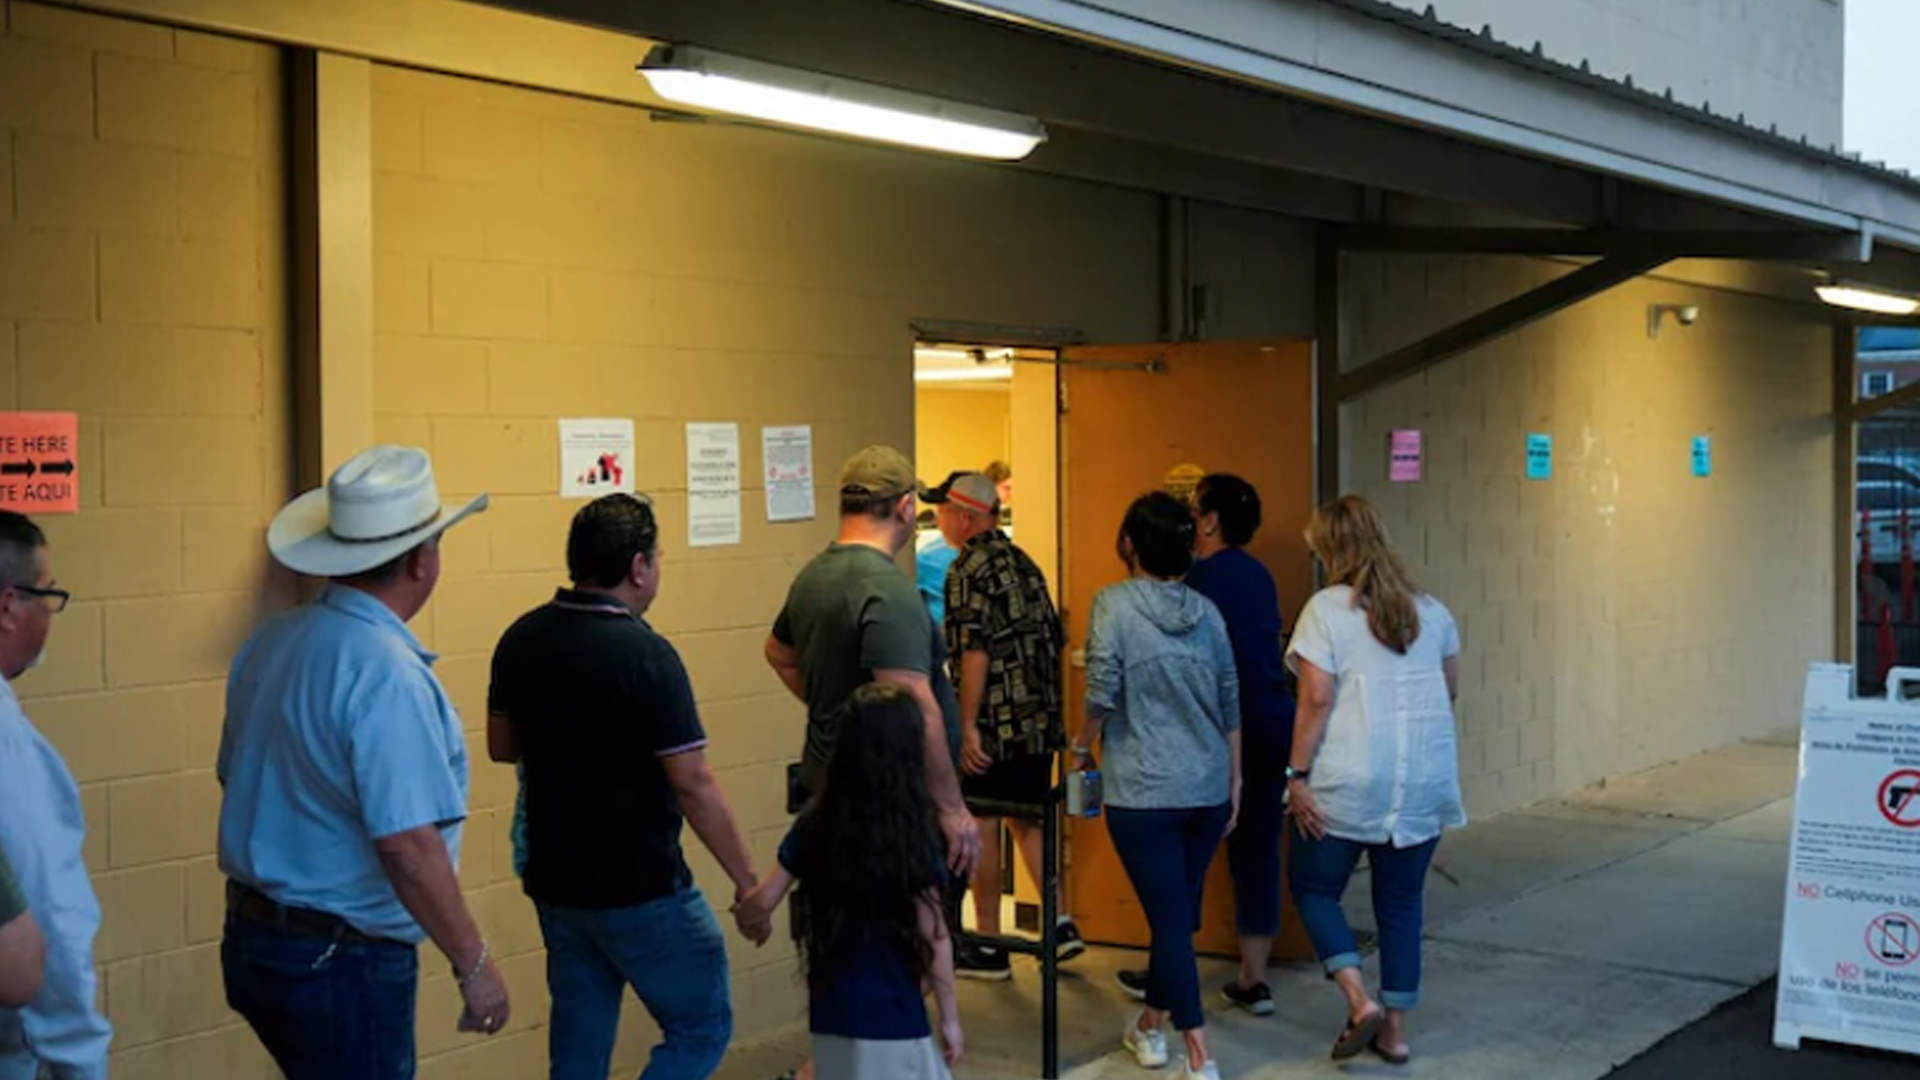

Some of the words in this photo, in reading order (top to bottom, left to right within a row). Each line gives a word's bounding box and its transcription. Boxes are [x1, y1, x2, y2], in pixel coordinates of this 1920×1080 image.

[23, 436, 68, 454] HERE
[23, 483, 71, 501] AQUI
[1797, 882, 1821, 900] NO
[1823, 885, 1896, 906] Cellphone
[1836, 962, 1860, 979] NO
[1819, 978, 1838, 991] de
[1841, 980, 1862, 995] los
